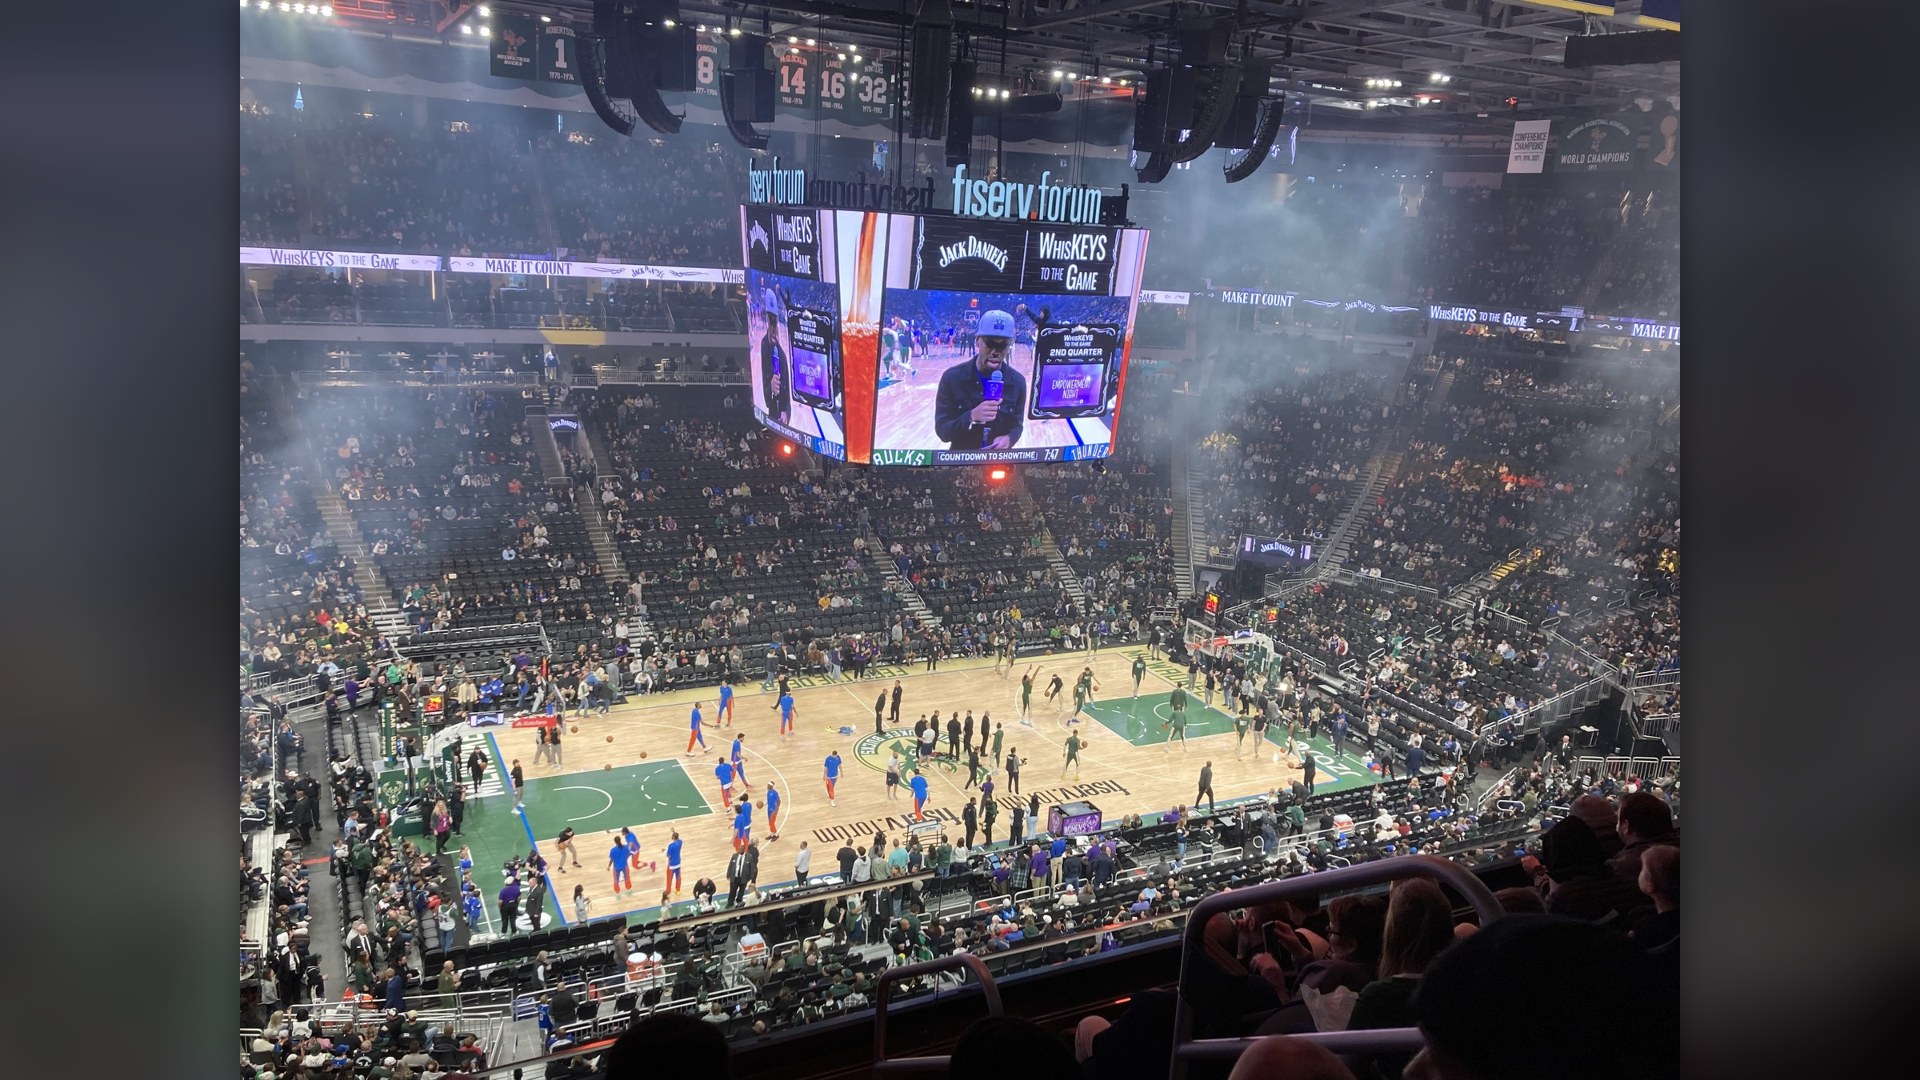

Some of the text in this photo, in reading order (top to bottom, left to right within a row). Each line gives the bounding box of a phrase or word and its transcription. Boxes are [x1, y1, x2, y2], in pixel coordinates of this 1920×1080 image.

[555, 39, 567, 68] 1
[698, 56, 714, 84] 8
[780, 65, 806, 95] 14
[821, 70, 846, 99] 16
[859, 75, 887, 104] 32
[1514, 132, 1548, 141] CONFERENCE
[1514, 141, 1544, 150] CHAMPIONS
[1560, 152, 1630, 164] WORLD CHAMPIONS
[338, 254, 350, 265] TO
[351, 255, 366, 266] THE
[371, 253, 400, 270] GAME
[793, 246, 812, 275] GAME
[939, 235, 1009, 273] JACK DANIEL'S
[485, 259, 573, 275] MAKE IT COUNT
[1040, 263, 1099, 291] TO THE GAME
[1222, 290, 1295, 307] MAKE IT COUNT
[1479, 311, 1488, 321] TO
[1488, 312, 1501, 323] THE
[1503, 311, 1528, 328] GAME
[803, 334, 825, 346] QUARTER
[1632, 323, 1680, 340] MAKE IT
[1049, 348, 1103, 357] 2ND QUARTER
[1051, 378, 1091, 390] EMPOWERMENT
[1062, 388, 1080, 399] NIGHT
[550, 419, 561, 429] JACK
[818, 441, 845, 461] THUNDER
[873, 450, 925, 466] BUCKS
[939, 450, 1036, 461] COUNTDOWN TO SHOWTIME
[1044, 448, 1059, 461] 7:47
[1070, 443, 1109, 461] THUNDER
[1260, 542, 1275, 553] JACK
